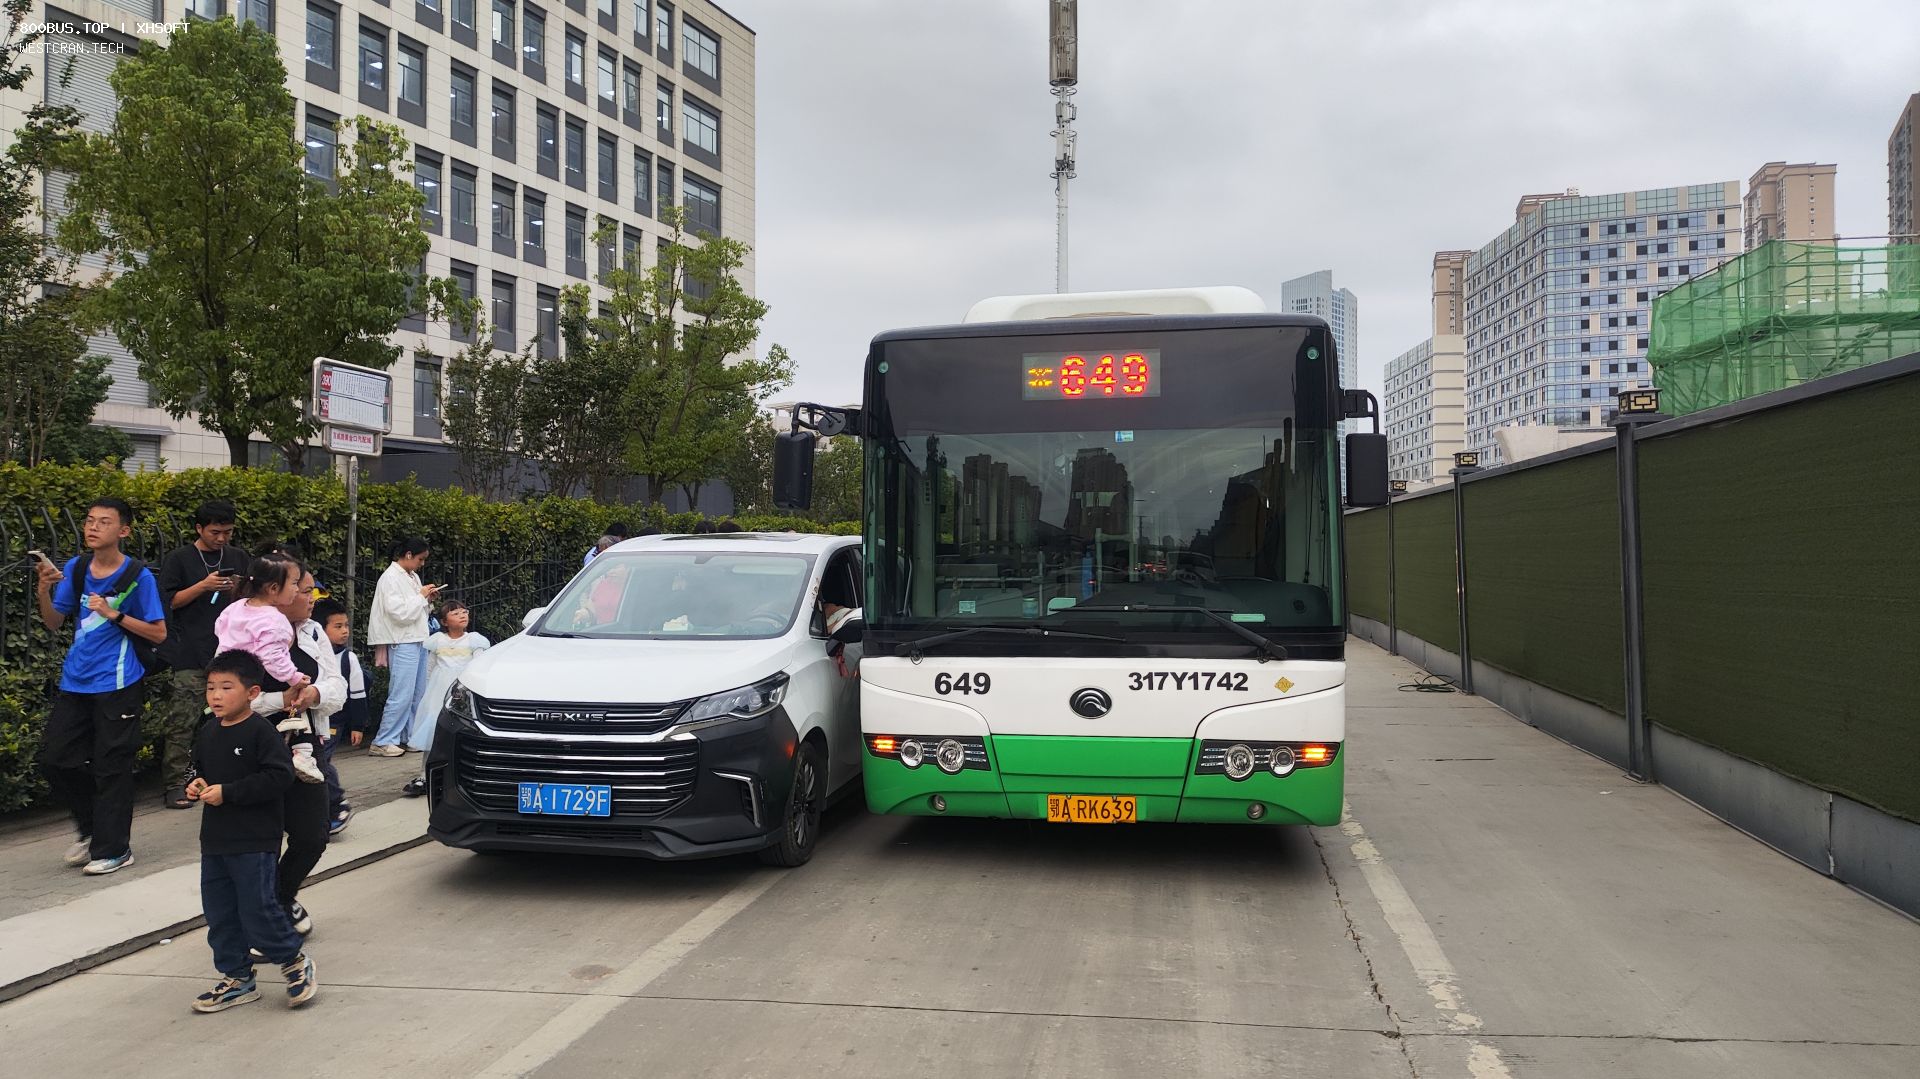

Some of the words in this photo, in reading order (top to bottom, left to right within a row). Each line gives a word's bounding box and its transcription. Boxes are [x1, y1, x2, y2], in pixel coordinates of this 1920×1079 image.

[1059, 353, 1149, 398] 649
[934, 672, 991, 695] 649
[1128, 671, 1249, 691] 317Y1742
[535, 712, 604, 722] MAXUS
